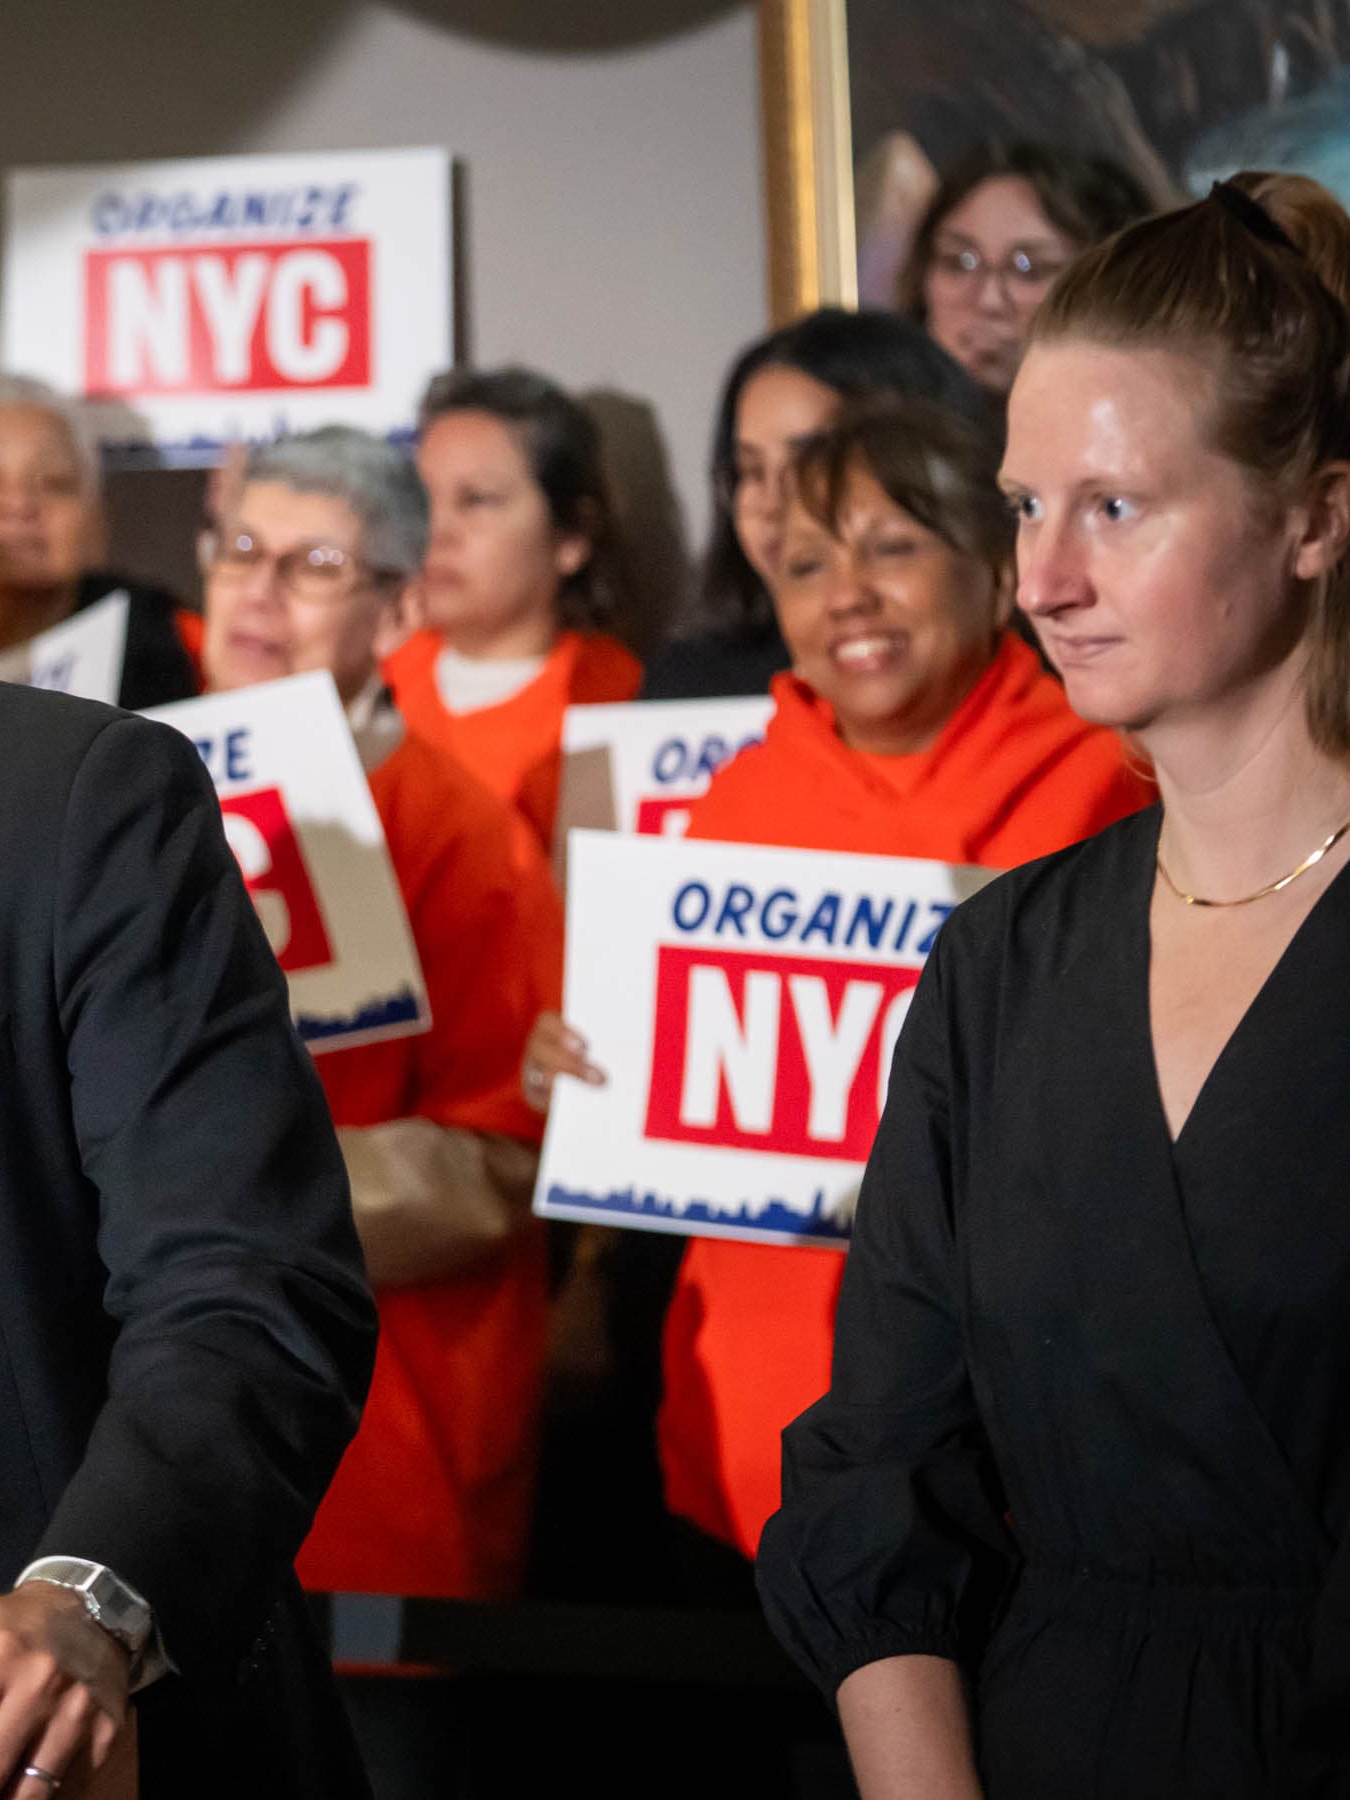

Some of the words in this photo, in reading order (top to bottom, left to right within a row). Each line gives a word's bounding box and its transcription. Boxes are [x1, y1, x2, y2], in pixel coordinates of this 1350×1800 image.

[91, 183, 358, 234] ORGANIZE
[106, 248, 349, 385] NYC
[672, 881, 956, 954] ORGANIZ
[679, 963, 917, 1143] NY
